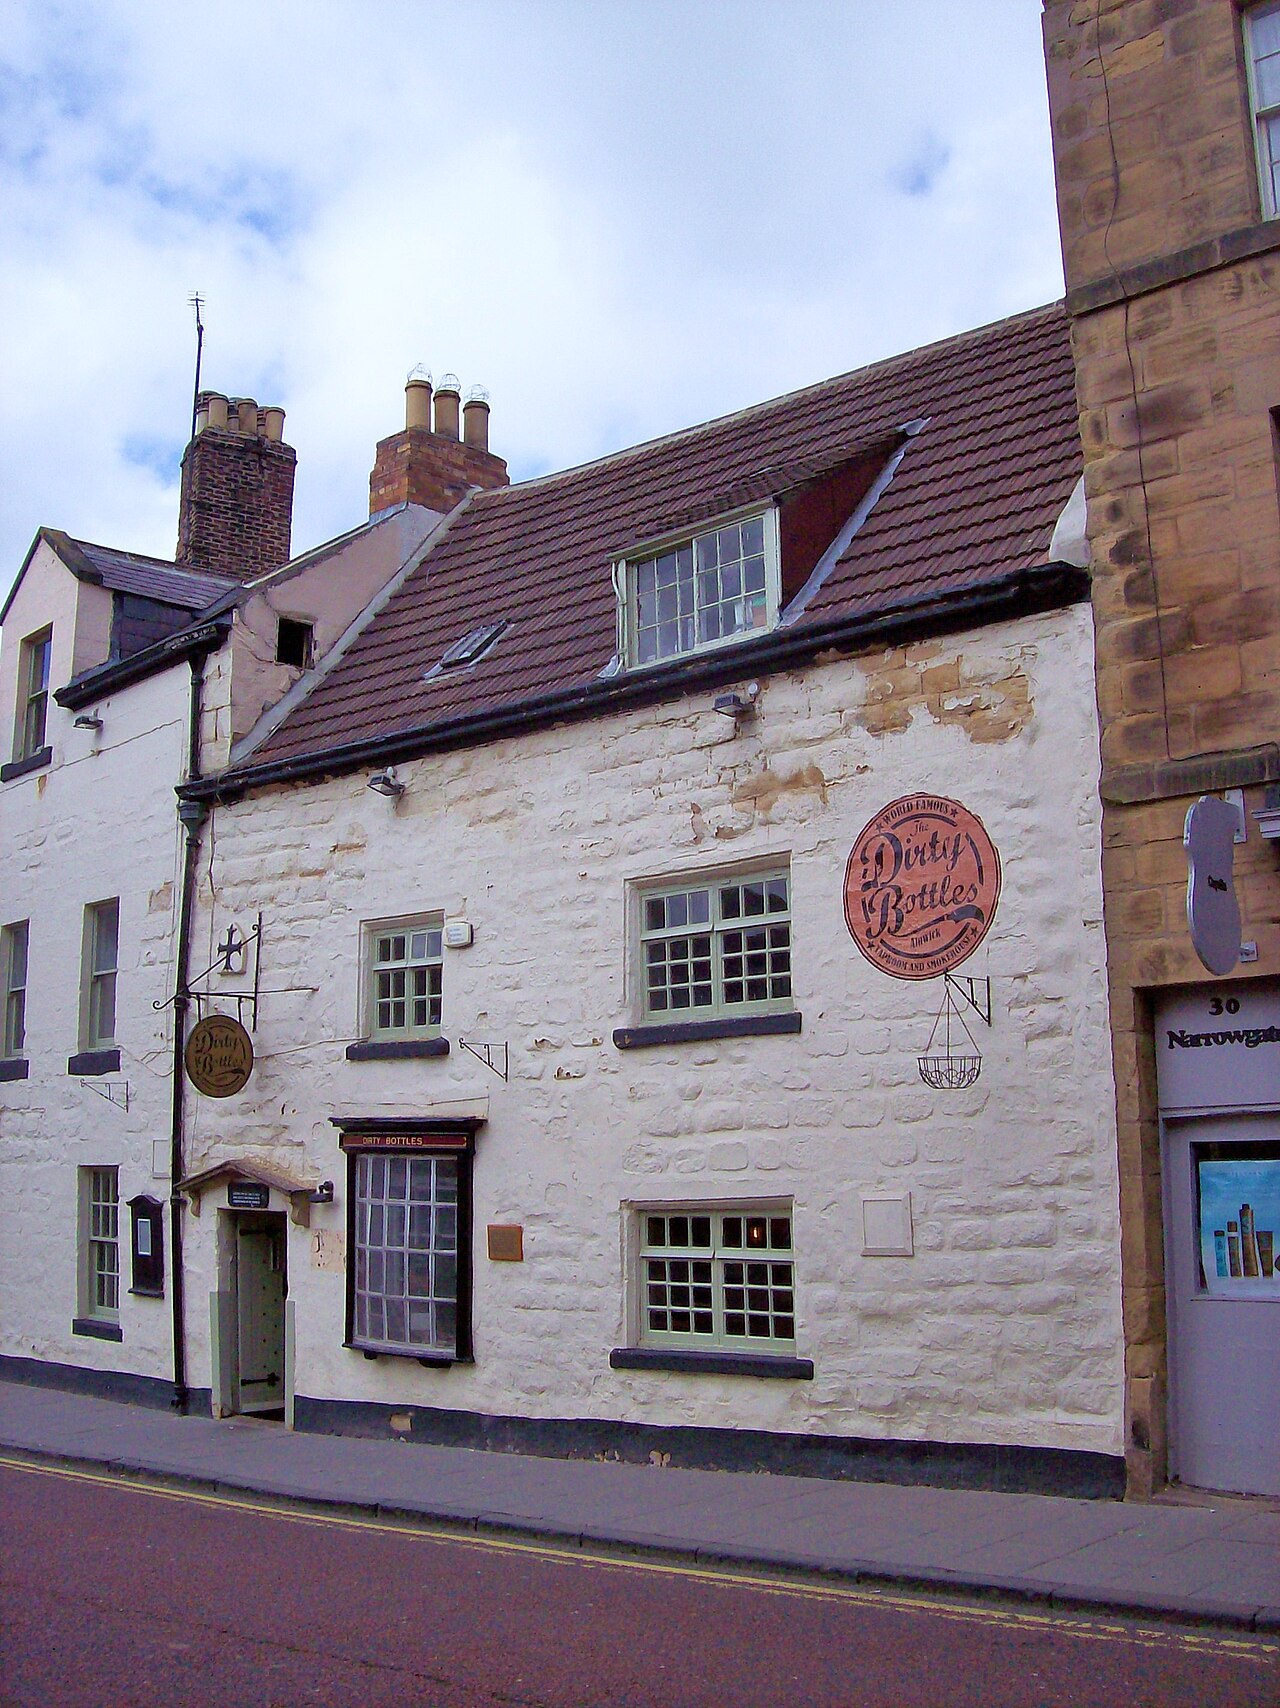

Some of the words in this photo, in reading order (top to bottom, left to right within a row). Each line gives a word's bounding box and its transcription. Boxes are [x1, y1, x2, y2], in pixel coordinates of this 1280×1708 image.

[883, 803, 913, 825] WORLD
[915, 799, 950, 815] FAMOUS
[910, 820, 930, 837] The
[860, 831, 966, 892] Dirty
[861, 875, 978, 939] Bottles
[910, 928, 941, 948] Alnwick
[874, 944, 909, 971] TAPROOM
[908, 962, 926, 972] AND
[927, 935, 972, 969] SMOKEHOUSE
[1208, 997, 1241, 1016] 30
[362, 1136, 381, 1145] DIRTY
[385, 1136, 423, 1146] BOTTLES
